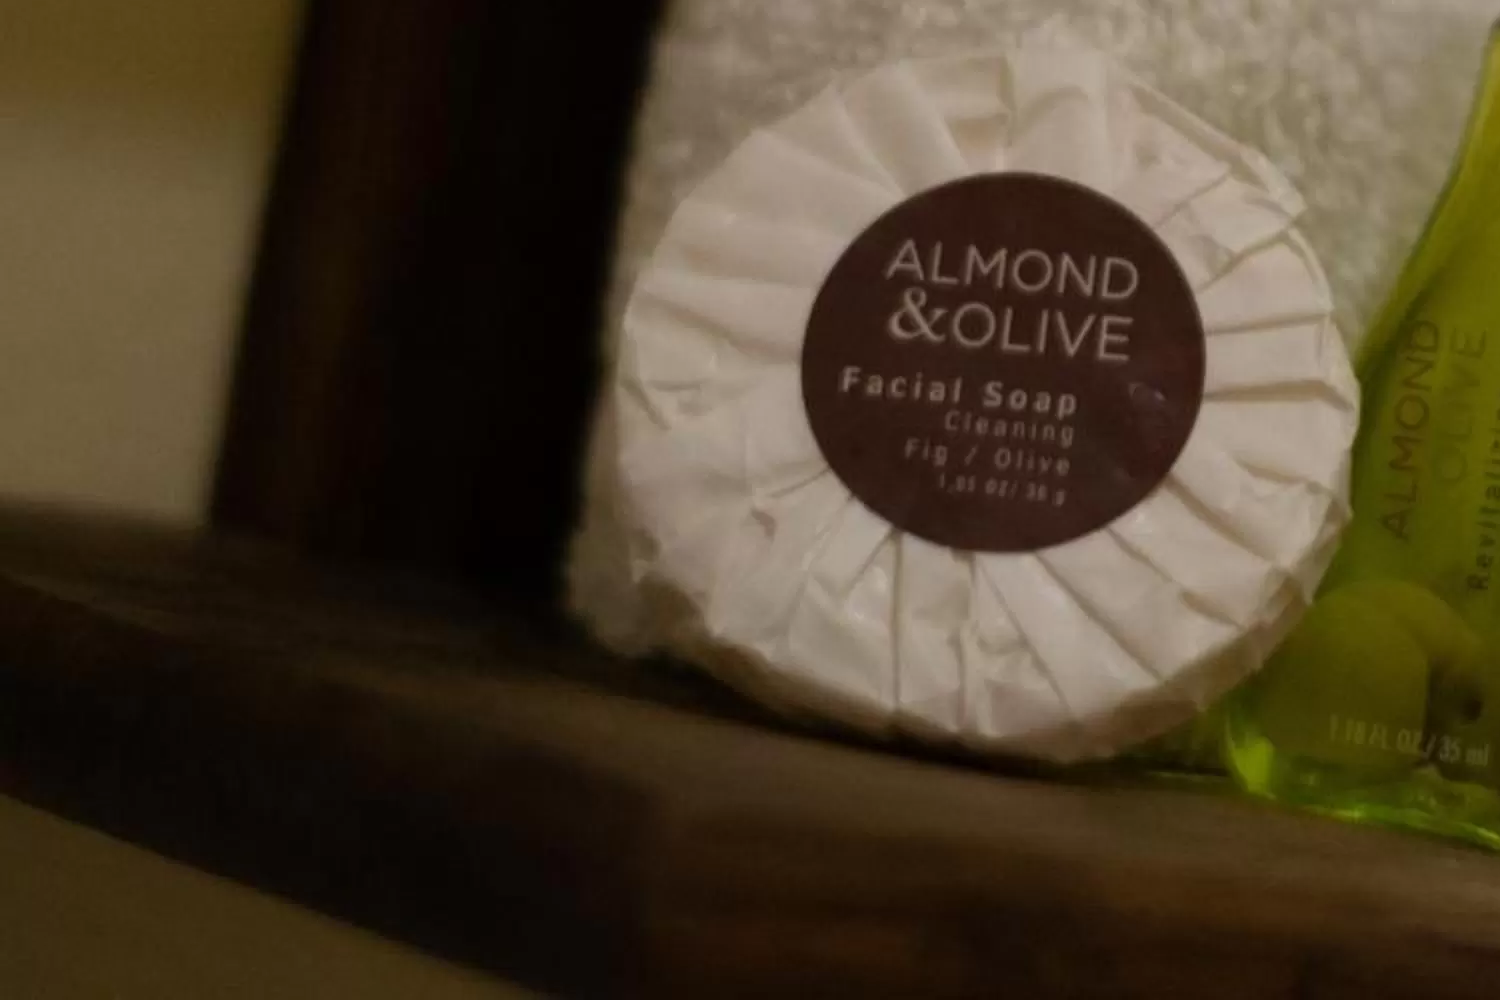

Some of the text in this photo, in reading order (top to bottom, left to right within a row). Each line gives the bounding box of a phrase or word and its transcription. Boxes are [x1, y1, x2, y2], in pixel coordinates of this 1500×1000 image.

[885, 239, 1139, 300] ALMOND
[888, 286, 1134, 362] &OLIVE
[841, 366, 1078, 420] Facial Soap
[904, 437, 948, 467] Fig
[993, 447, 1071, 476] Olive
[945, 410, 1075, 448] Cleaning
[1377, 319, 1440, 542] ALMOND
